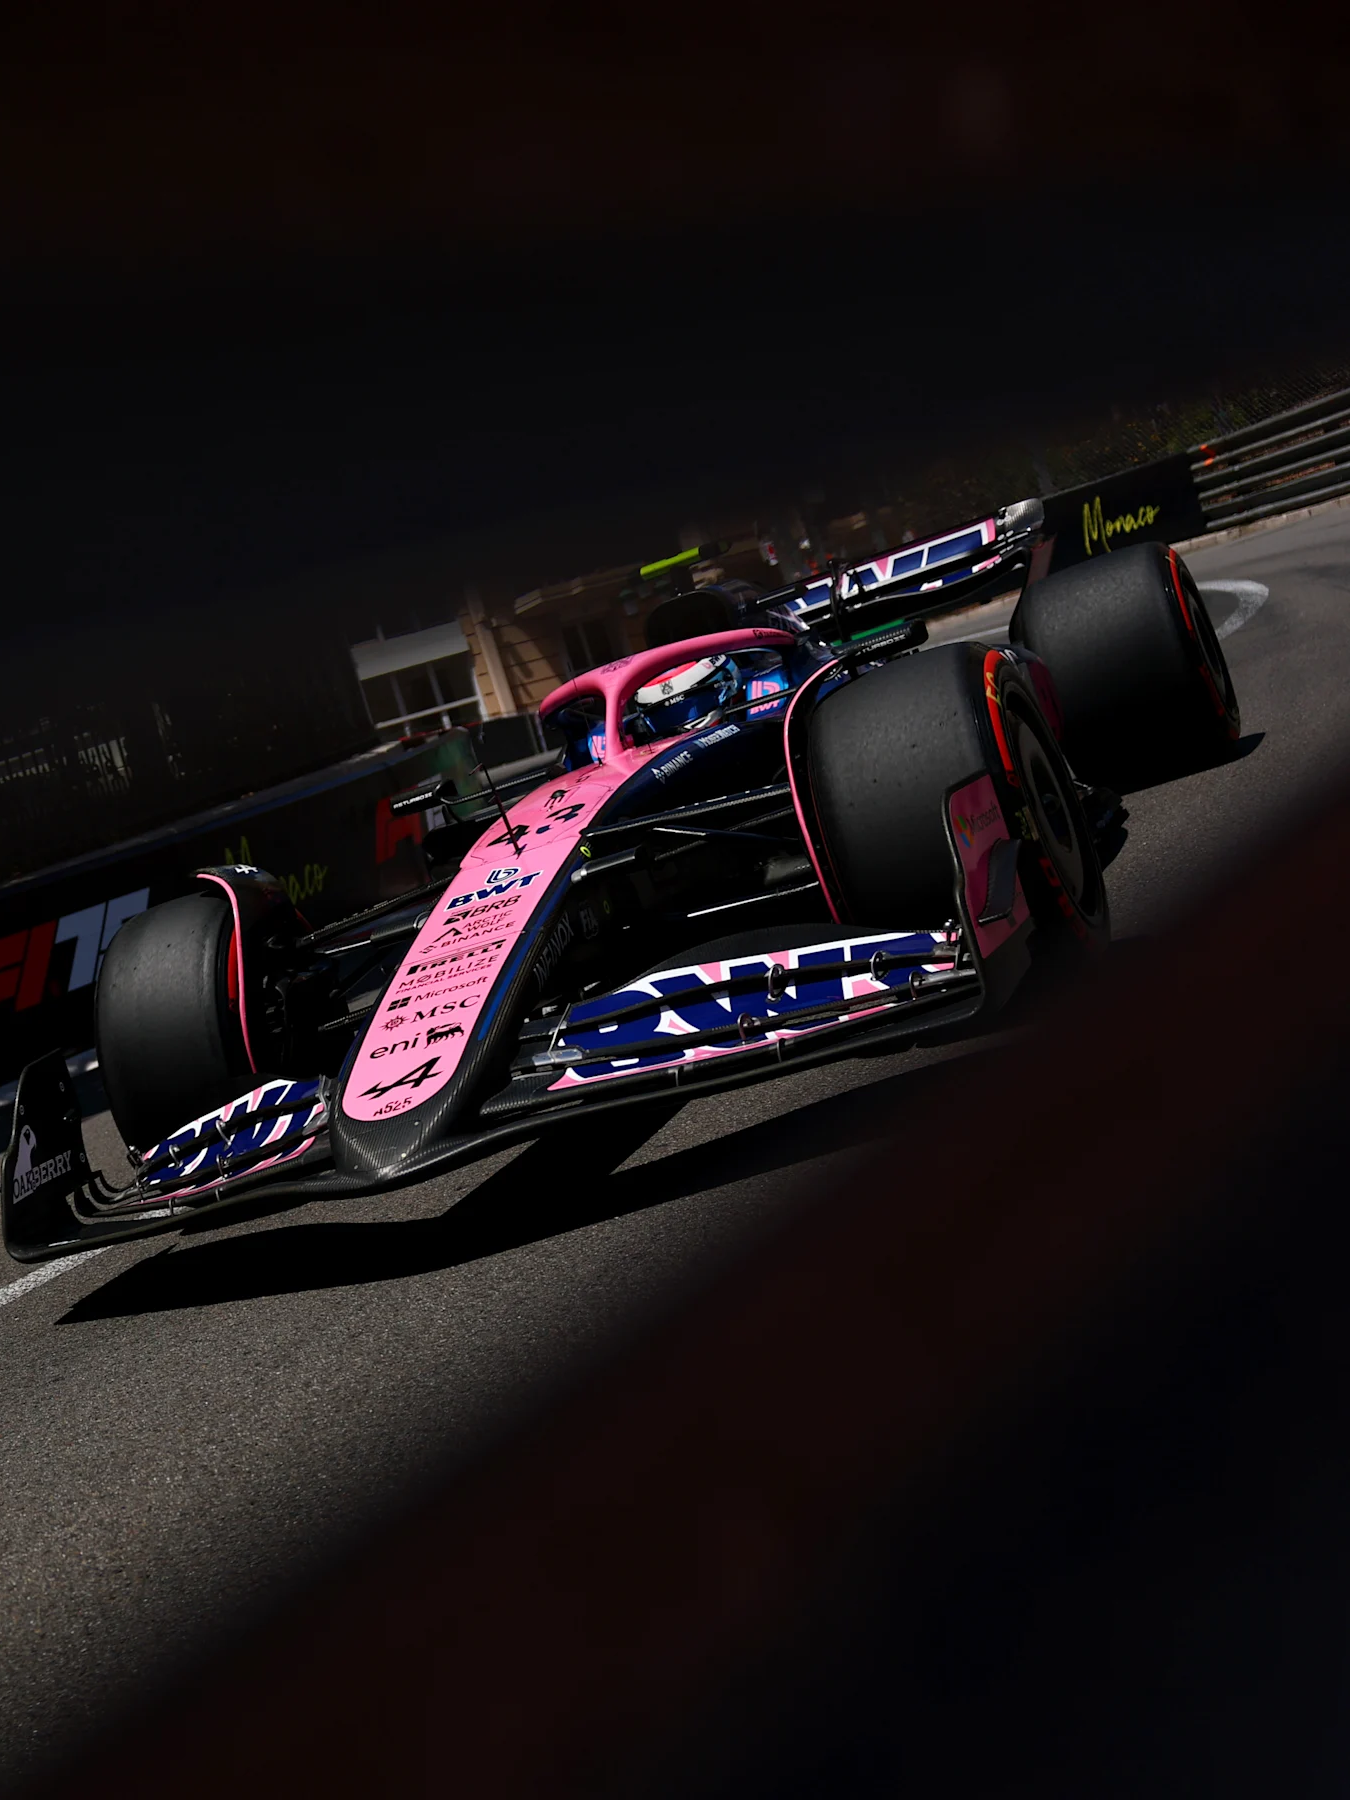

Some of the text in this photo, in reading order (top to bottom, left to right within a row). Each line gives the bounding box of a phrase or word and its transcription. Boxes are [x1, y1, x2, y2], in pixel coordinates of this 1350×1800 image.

[1082, 495, 1161, 556] Monaco
[659, 750, 693, 777] BINANCE
[445, 871, 542, 911] BWT
[441, 920, 516, 947] BINANCE
[463, 910, 513, 929] ARCTIC
[467, 918, 506, 932] WOLF
[534, 911, 575, 992] INFINOX
[396, 964, 492, 994] FINANCIAL SERVICES
[414, 976, 488, 1002] Microsoft
[410, 994, 481, 1023] MSC
[369, 1032, 421, 1059] eni
[12, 1149, 72, 1200] OAKBERRY
